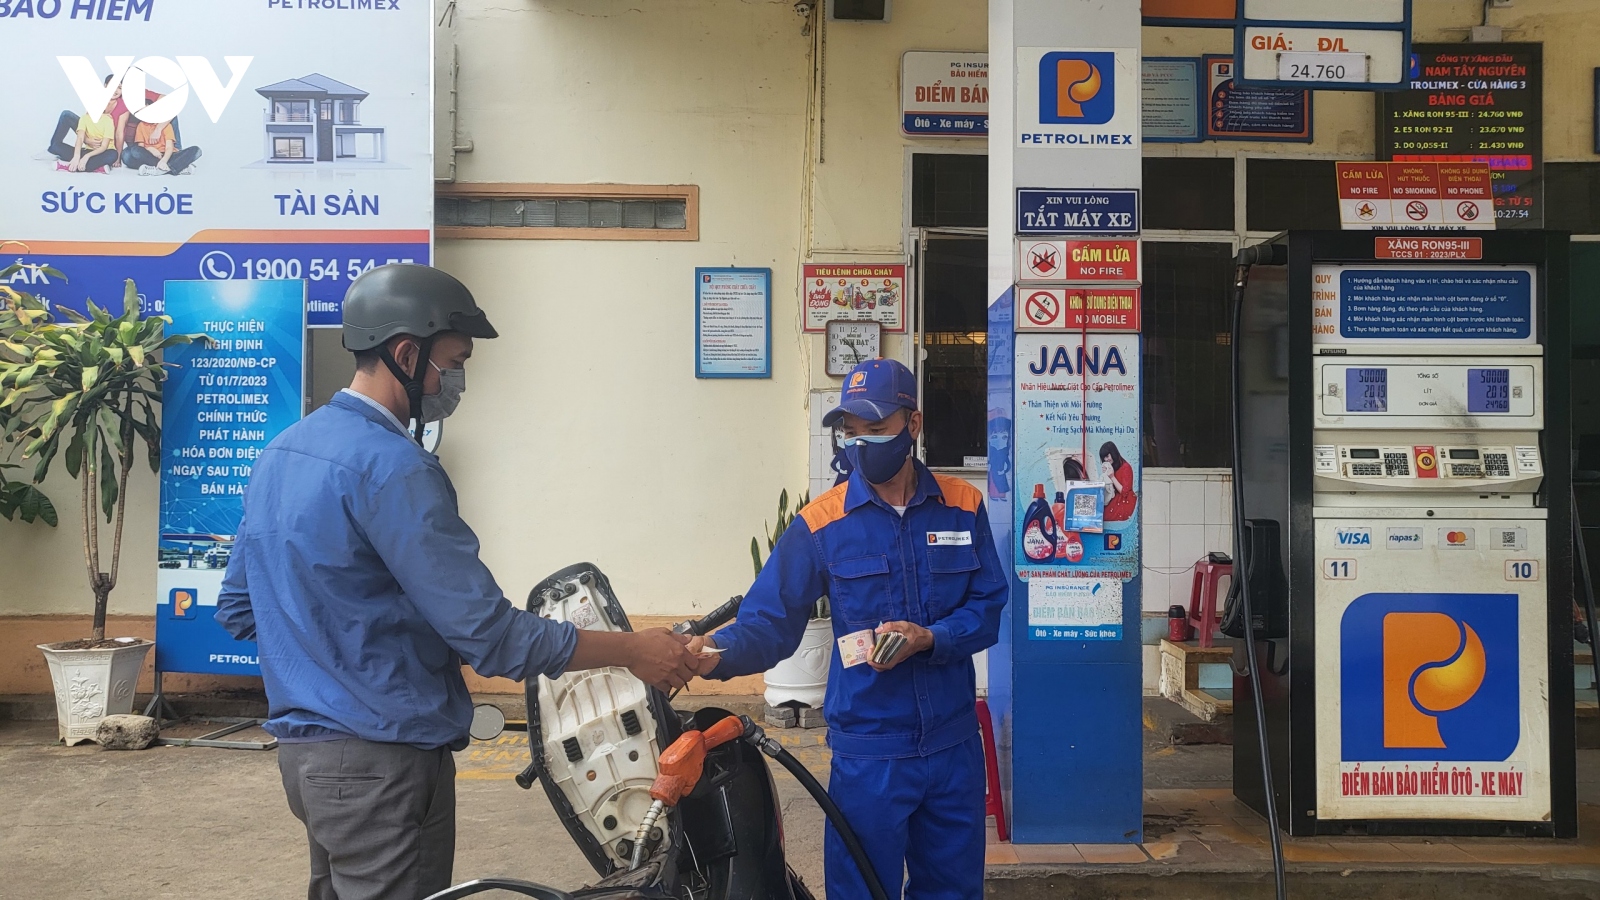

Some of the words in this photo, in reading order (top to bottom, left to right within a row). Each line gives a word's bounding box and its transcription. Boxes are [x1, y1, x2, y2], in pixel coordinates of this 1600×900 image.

[1252, 33, 1293, 51] GIÁ:
[1317, 38, 1349, 52] Đ/L
[1436, 54, 1458, 62] CÔNG
[1291, 64, 1345, 79] 24.760
[1425, 66, 1451, 76] NAM
[1454, 64, 1475, 76] TÂY
[1478, 63, 1526, 76] NGUYÊN
[1468, 80, 1488, 89] CỬA
[1490, 79, 1518, 89] HÀNG
[1520, 81, 1526, 89] 3
[915, 80, 956, 102] ĐIỂM
[1428, 92, 1466, 106] BẢNG
[1469, 92, 1494, 106] GIÁ
[1402, 110, 1426, 118] XĂNG
[914, 117, 930, 128] Ôtô
[940, 118, 952, 128] Xe
[954, 118, 974, 129] máy
[1022, 134, 1132, 144] PETROLIMEX
[1342, 168, 1362, 179] CẤM
[1366, 168, 1384, 180] LỬA
[41, 187, 106, 214] SỨC
[114, 188, 193, 215] KHỎE
[274, 189, 316, 215] TÀI
[324, 189, 379, 216] SẢN
[1084, 194, 1109, 204] LÒNG
[1024, 204, 1058, 227] TẮT
[1064, 208, 1103, 227] MÁY
[1108, 213, 1132, 227] XE
[1388, 238, 1418, 250] XĂNG
[1422, 240, 1470, 250] RON95-III
[1072, 244, 1102, 262] CẤM
[1106, 244, 1130, 262] LỬA
[242, 258, 302, 280] 1900
[309, 259, 340, 280] 54
[816, 268, 831, 276] TIÊU
[874, 268, 892, 276] CHÁY
[1315, 274, 1332, 284] QUY
[1315, 306, 1332, 318] BÁN
[1092, 315, 1126, 324] MOBILE
[204, 320, 234, 334] THỰC
[237, 319, 264, 334] HIỆN
[1312, 322, 1335, 334] HÀNG
[204, 340, 232, 352] NGHỊ
[236, 340, 263, 352] ĐỊNH
[190, 358, 276, 368] 123/2020/NĐ-CP
[1028, 345, 1127, 376] JANA
[199, 374, 214, 386] TỪ
[216, 376, 268, 386] 01/7/2023
[1359, 370, 1386, 383] 50000
[1480, 370, 1508, 384] 50000
[1104, 383, 1134, 392] Petrolimex
[197, 394, 270, 404] PETROLIMEX
[1486, 400, 1508, 408] 24760
[197, 410, 232, 422] CHÍNH
[236, 410, 268, 422] THỨC
[199, 428, 229, 440] PHÁT
[232, 428, 265, 440] HÀNH
[1126, 426, 1134, 434] Da
[182, 446, 206, 458] HÓA
[208, 448, 232, 458] ĐƠN
[173, 465, 204, 476] NGAY
[206, 466, 228, 476] SAU
[201, 482, 224, 494] BÁN
[1338, 532, 1370, 545] VISA
[1389, 532, 1412, 544] napas
[1330, 562, 1349, 577] 11
[1512, 562, 1532, 578] 10
[1036, 628, 1046, 638] Ôtô
[1053, 629, 1062, 637] Xe
[1064, 630, 1078, 638] máy
[1084, 628, 1098, 638] Sức
[1342, 762, 1370, 796] ĐIỂM
[1372, 766, 1394, 796] BÁN
[1396, 764, 1418, 796] BẢO
[1420, 762, 1449, 795] HIỂM
[1451, 766, 1472, 795] ÔTÔ
[1481, 772, 1496, 796] XE
[1498, 766, 1523, 796] MÁY
